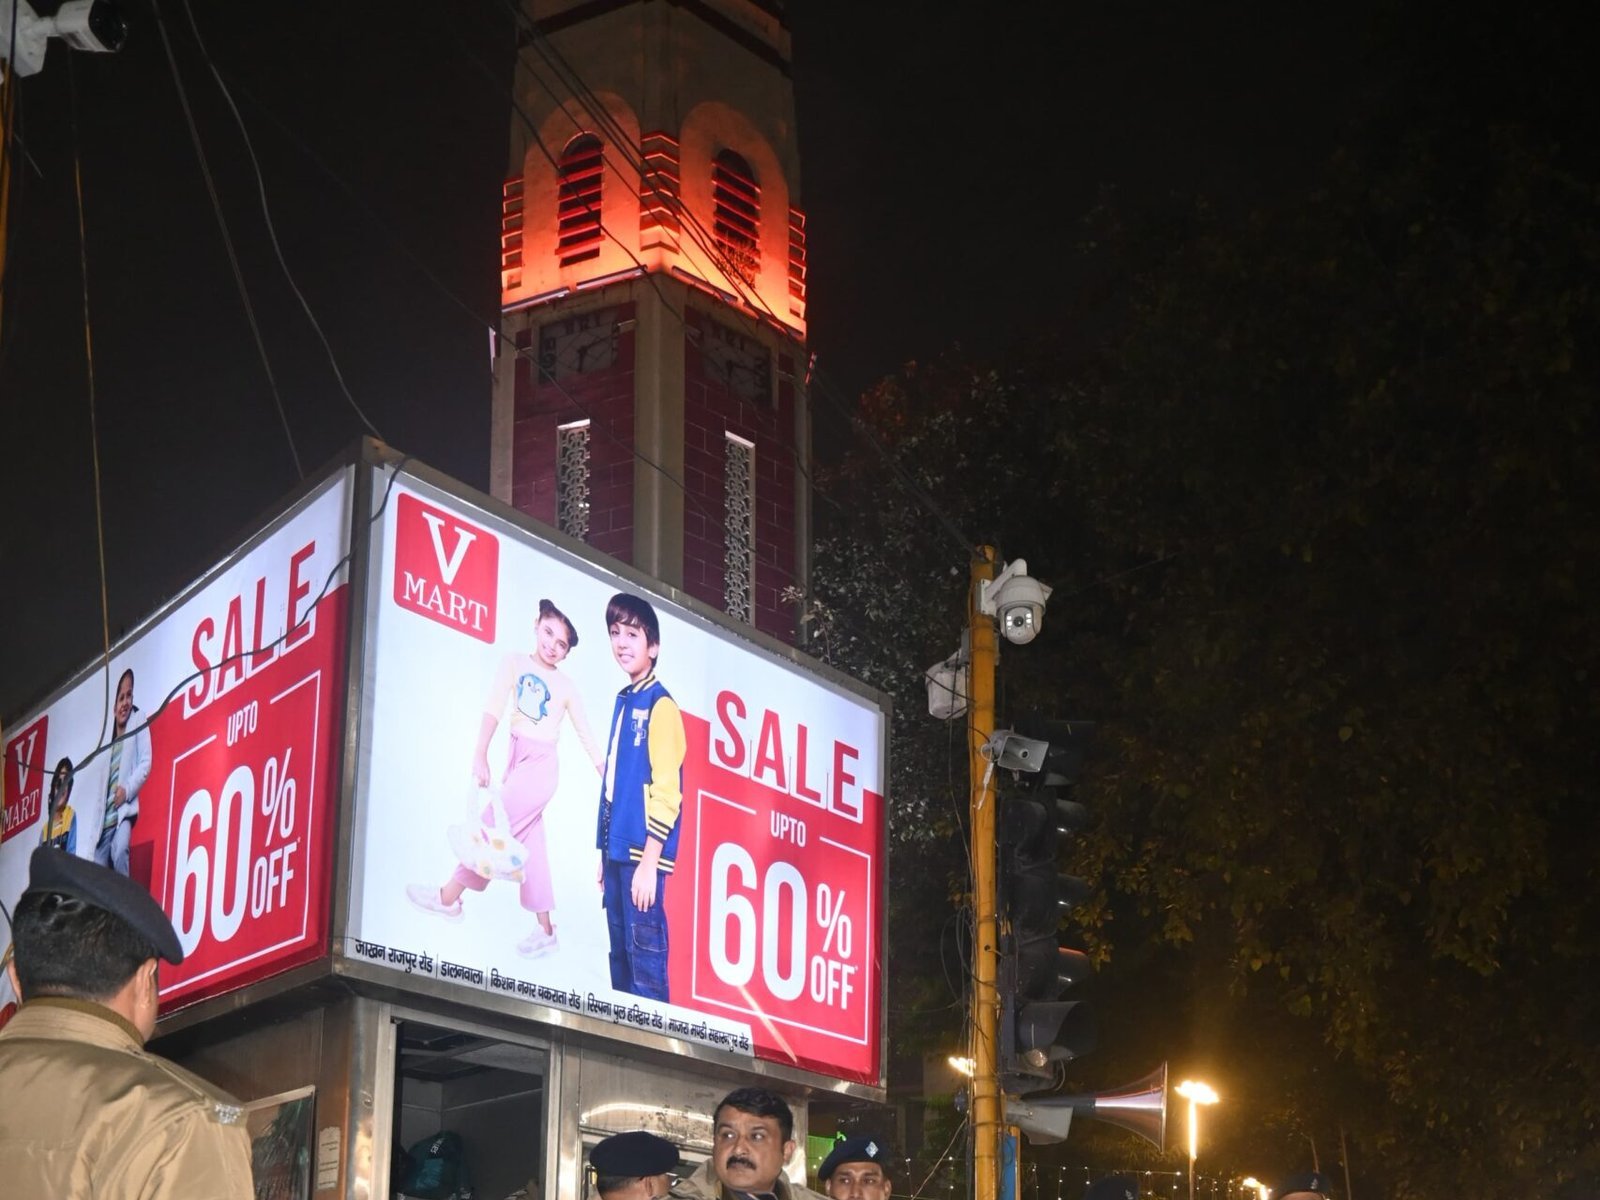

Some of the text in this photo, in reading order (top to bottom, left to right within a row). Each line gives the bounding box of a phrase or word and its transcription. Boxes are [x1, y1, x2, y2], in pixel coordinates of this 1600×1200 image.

[422, 511, 477, 586] V
[190, 540, 316, 706] SALE
[402, 571, 488, 632] MART
[227, 701, 259, 747] UPTO
[714, 689, 861, 819] SALE
[15, 729, 38, 795] V
[2, 788, 40, 834] MART
[770, 809, 807, 848] UPTO
[355, 939, 386, 960] जाखन
[388, 947, 417, 974] राजपुर
[419, 951, 434, 973] रोड
[441, 960, 483, 985] डालनवाला
[490, 968, 516, 992] किशन
[517, 980, 536, 998] नगर
[538, 985, 567, 1005] चकराता
[568, 988, 581, 1010] रोड
[587, 992, 612, 1015] रिस्पना
[613, 1004, 627, 1024] पुल
[627, 1003, 651, 1026] हरिद्वार
[651, 1009, 663, 1029] रोड
[739, 1032, 750, 1051] रोड
